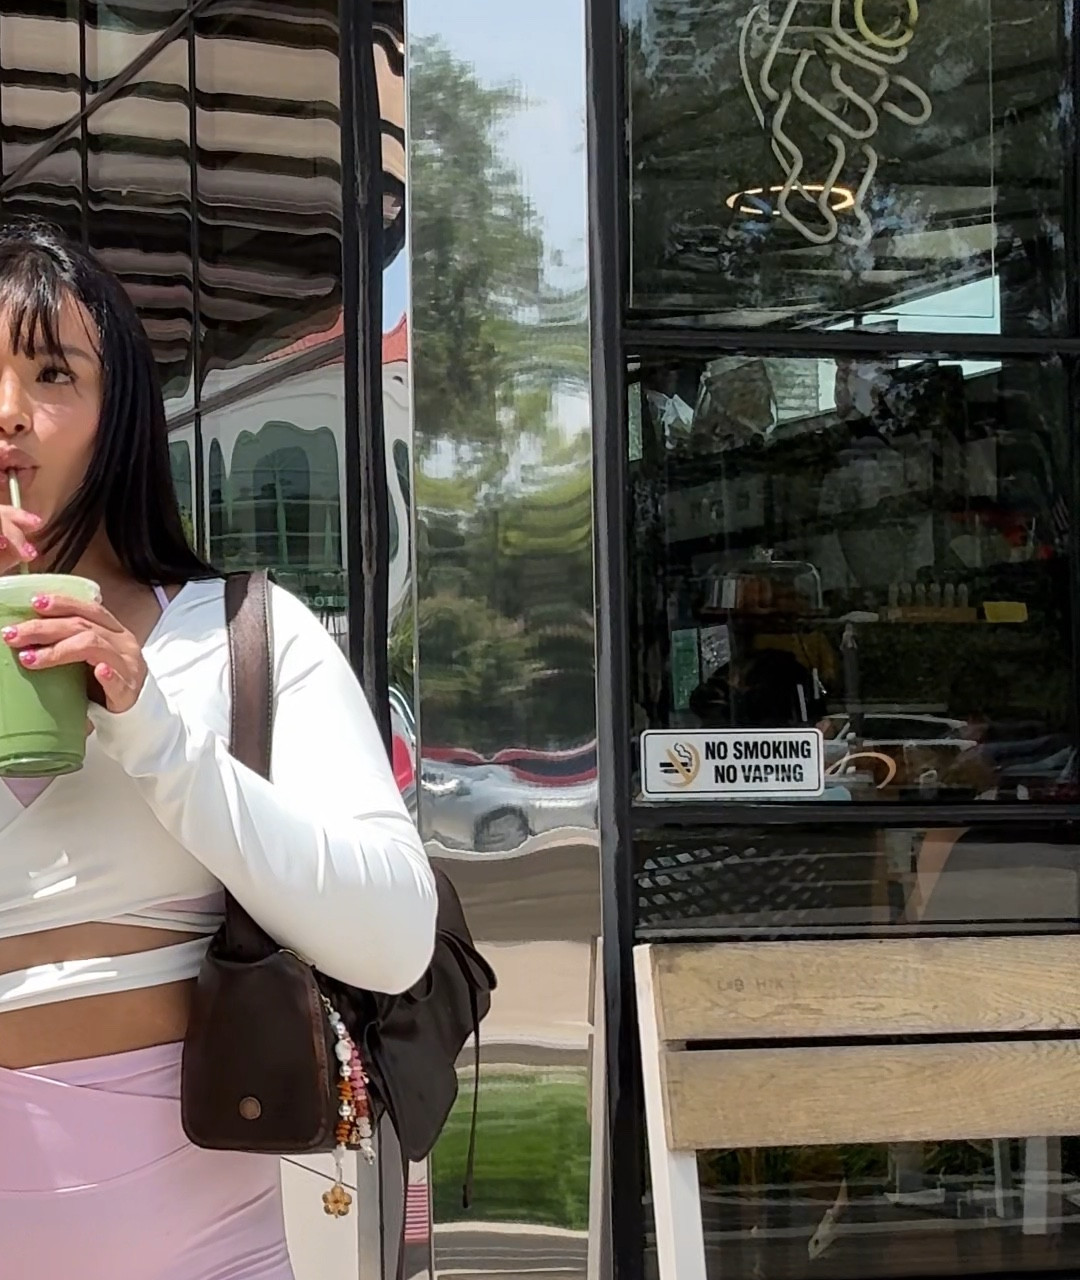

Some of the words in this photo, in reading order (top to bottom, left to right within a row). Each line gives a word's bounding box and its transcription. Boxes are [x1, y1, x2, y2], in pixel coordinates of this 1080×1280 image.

[705, 741, 728, 760] NO
[733, 740, 812, 760] SMOKING
[714, 765, 737, 784] NO
[741, 764, 804, 783] VAPING
